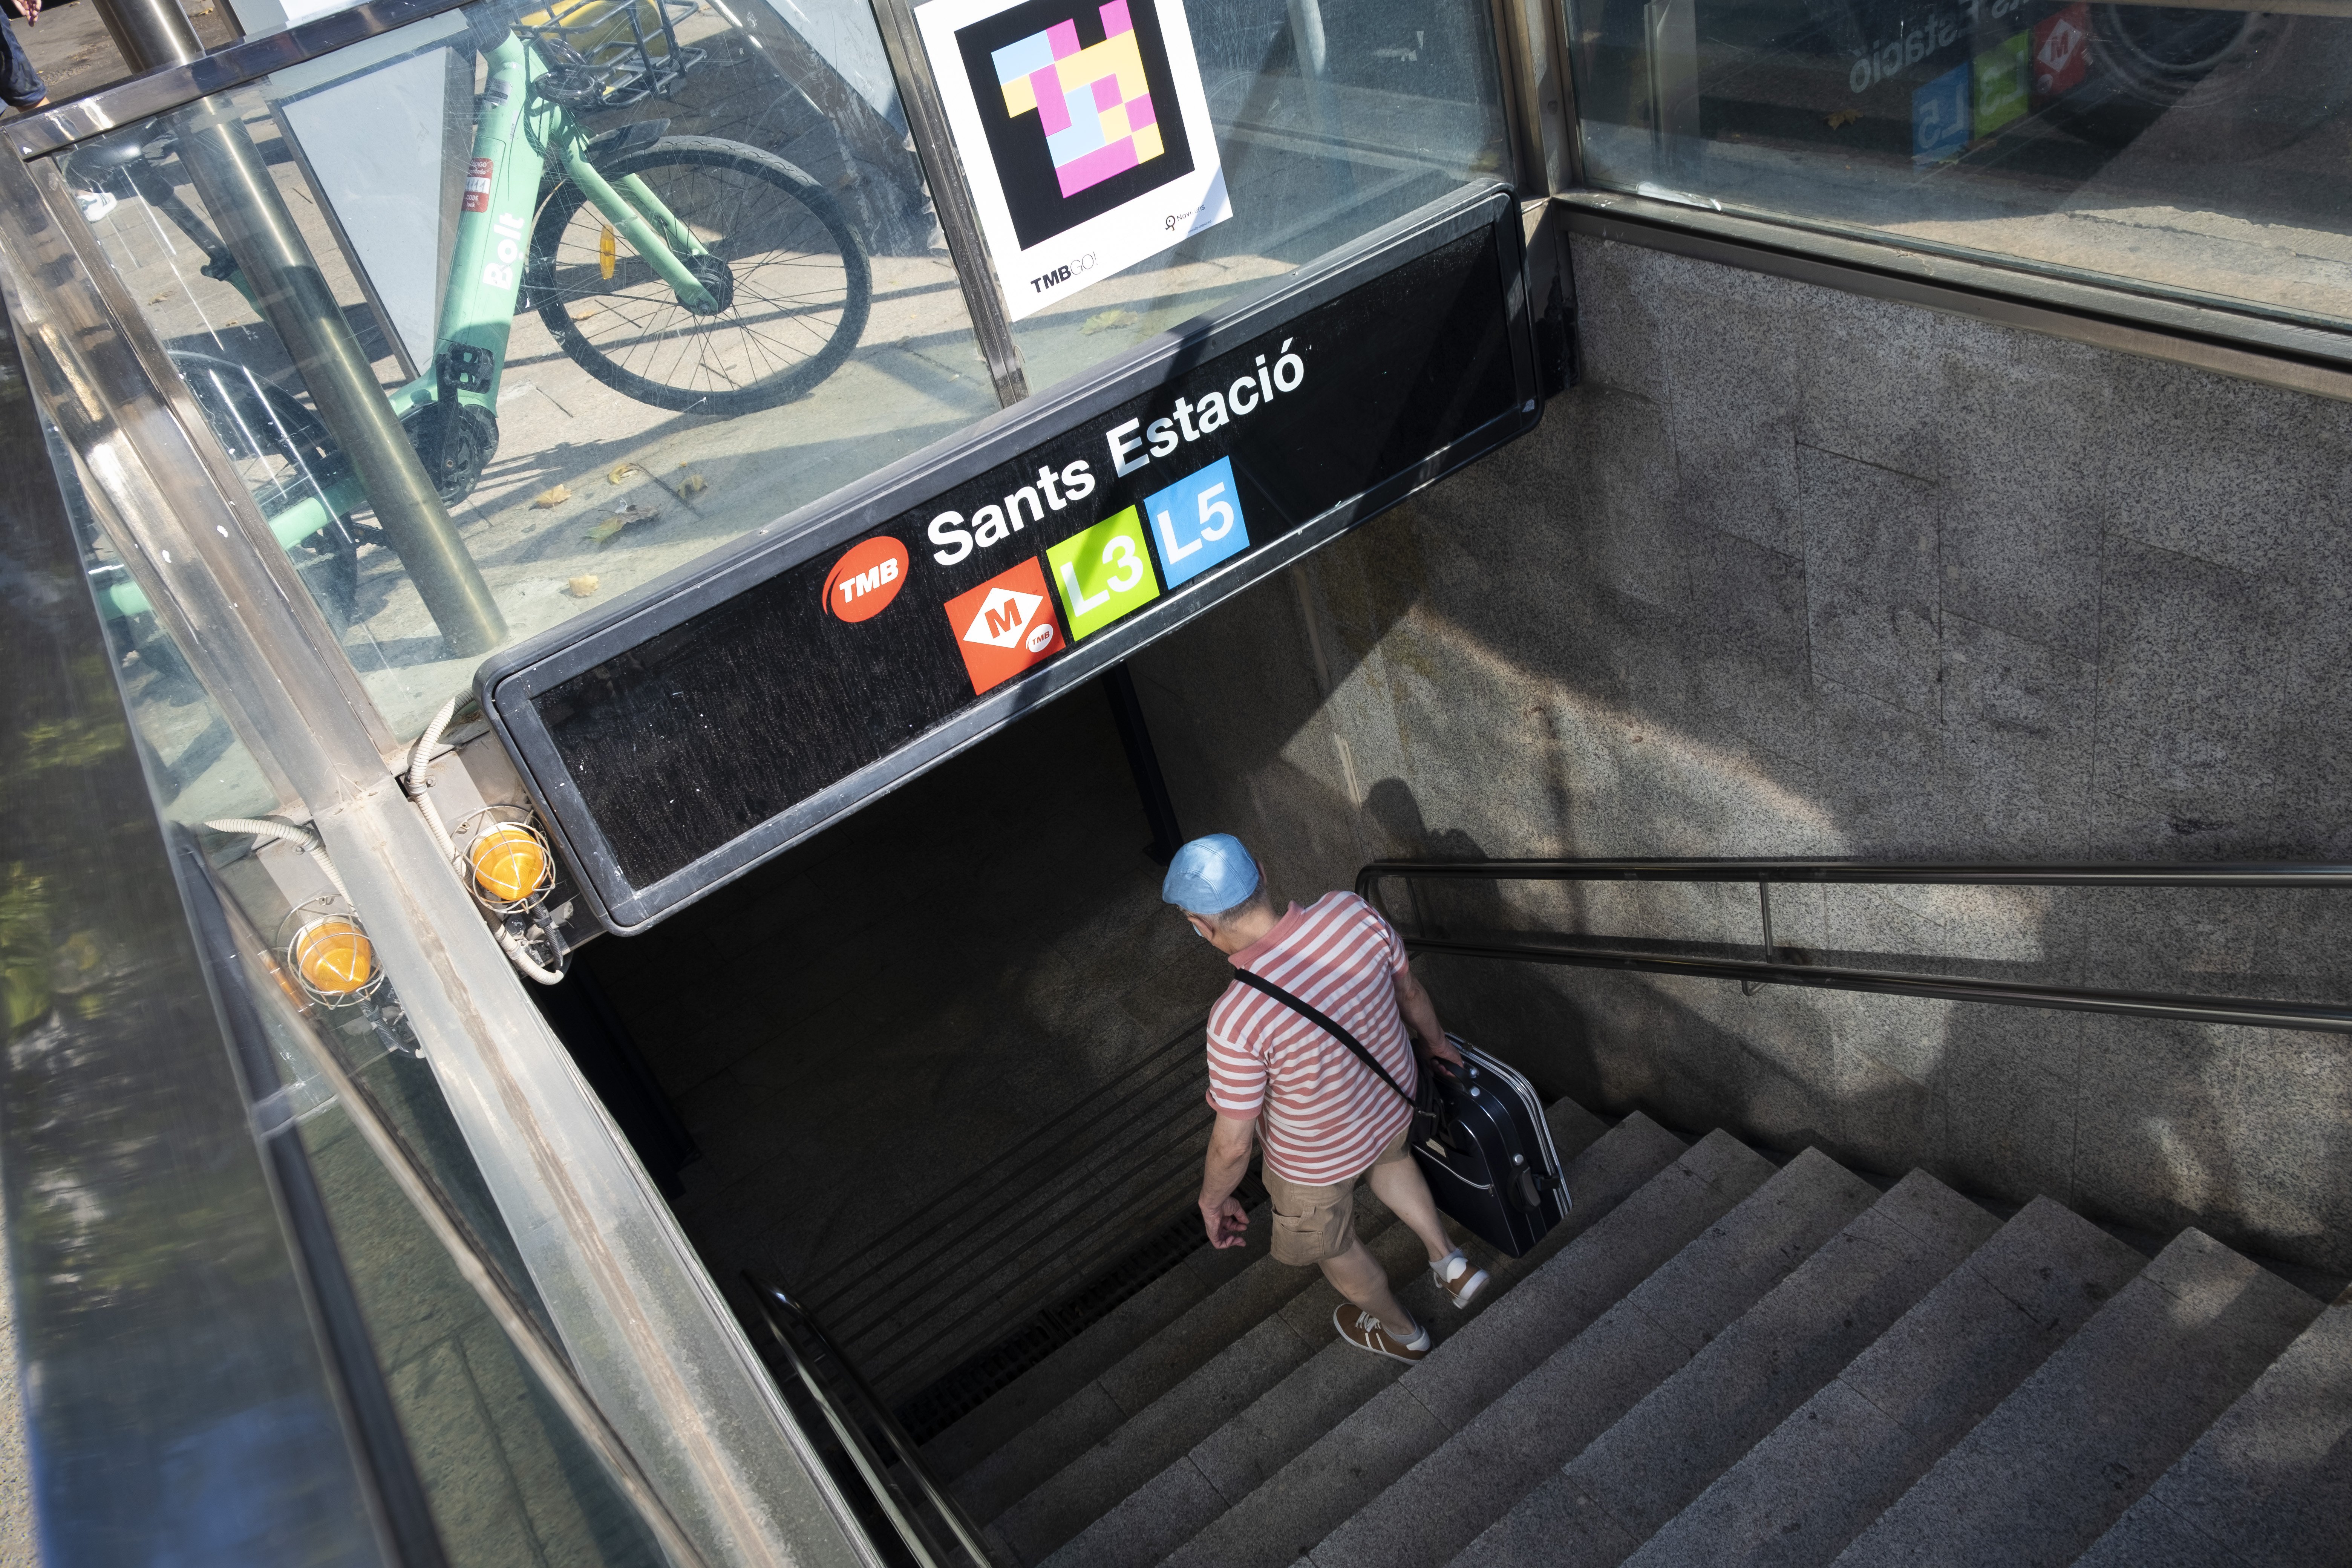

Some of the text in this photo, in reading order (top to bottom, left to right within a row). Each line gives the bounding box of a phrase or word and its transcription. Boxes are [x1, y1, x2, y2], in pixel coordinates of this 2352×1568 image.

[482, 213, 524, 290] Bolt
[927, 337, 1305, 566] Sants Estació
[1061, 481, 1234, 617] L3 L5
[839, 558, 899, 603] TMB
[985, 598, 1022, 639] M
[1032, 631, 1050, 645] TMB
